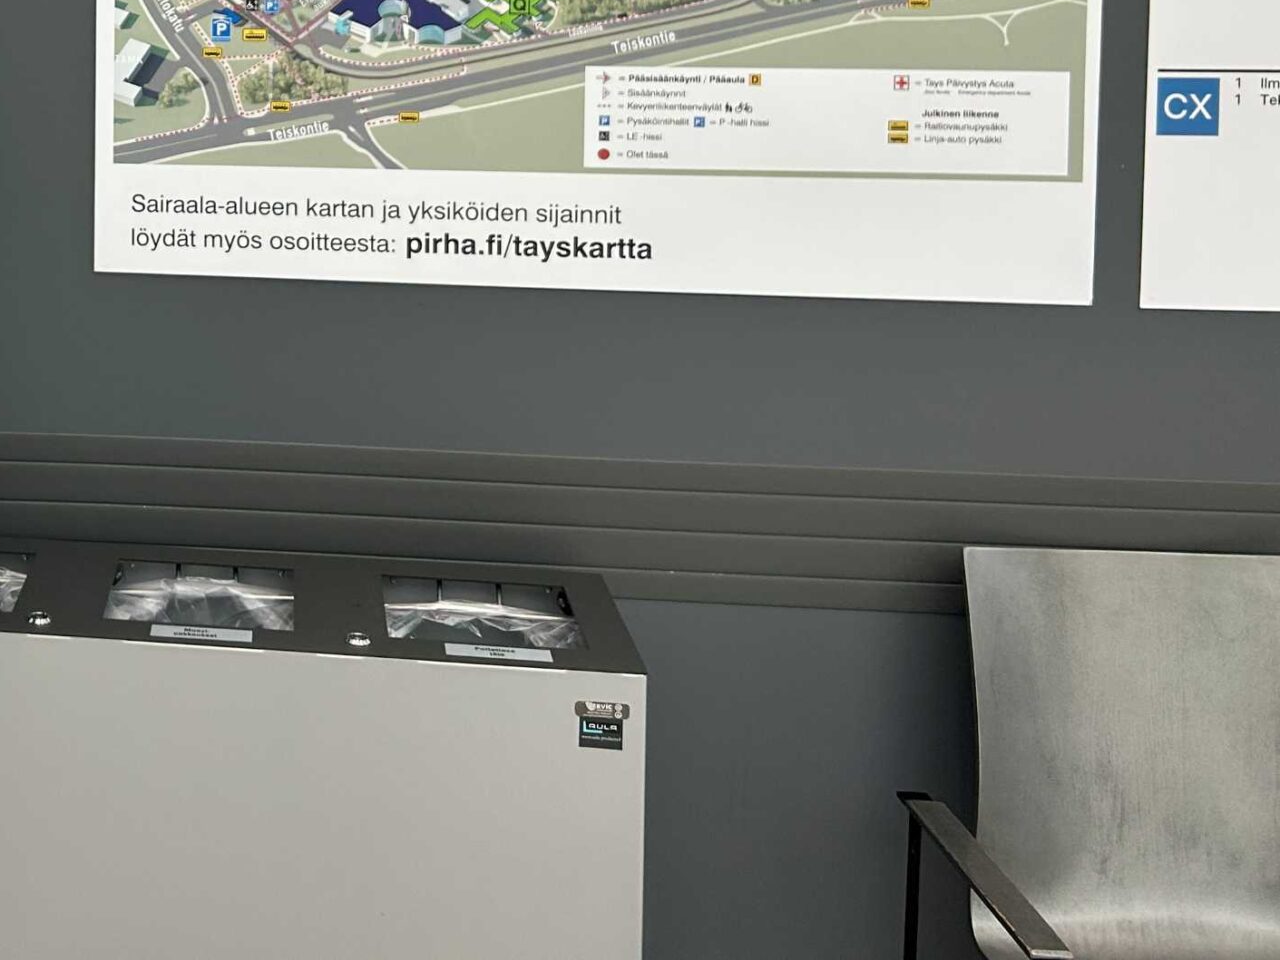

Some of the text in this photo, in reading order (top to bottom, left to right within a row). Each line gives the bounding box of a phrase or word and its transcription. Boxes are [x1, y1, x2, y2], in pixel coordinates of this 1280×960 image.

[611, 30, 676, 54] Teiskontie
[628, 74, 701, 84] Pääsisäänkäynti
[710, 75, 746, 84] Pääaula
[924, 78, 1015, 89] Tays Päivystys Acuta
[627, 88, 686, 99] Sisäänkäynnit
[1163, 77, 1241, 120] CX 1
[1235, 94, 1241, 106] 1
[922, 109, 999, 118] Julkinen liikenne
[627, 116, 689, 127] Pysäköintihallit
[750, 118, 770, 127] hissi
[270, 120, 330, 141] Teiskontie
[969, 136, 1002, 145] pysäkki
[626, 150, 669, 159] Olet tässä
[131, 194, 622, 227] Sairaala-alueen kartan ja yksiköiden sijainnit
[131, 227, 653, 263] löydät myös osoitteesta: pirha.fi/tayskartta
